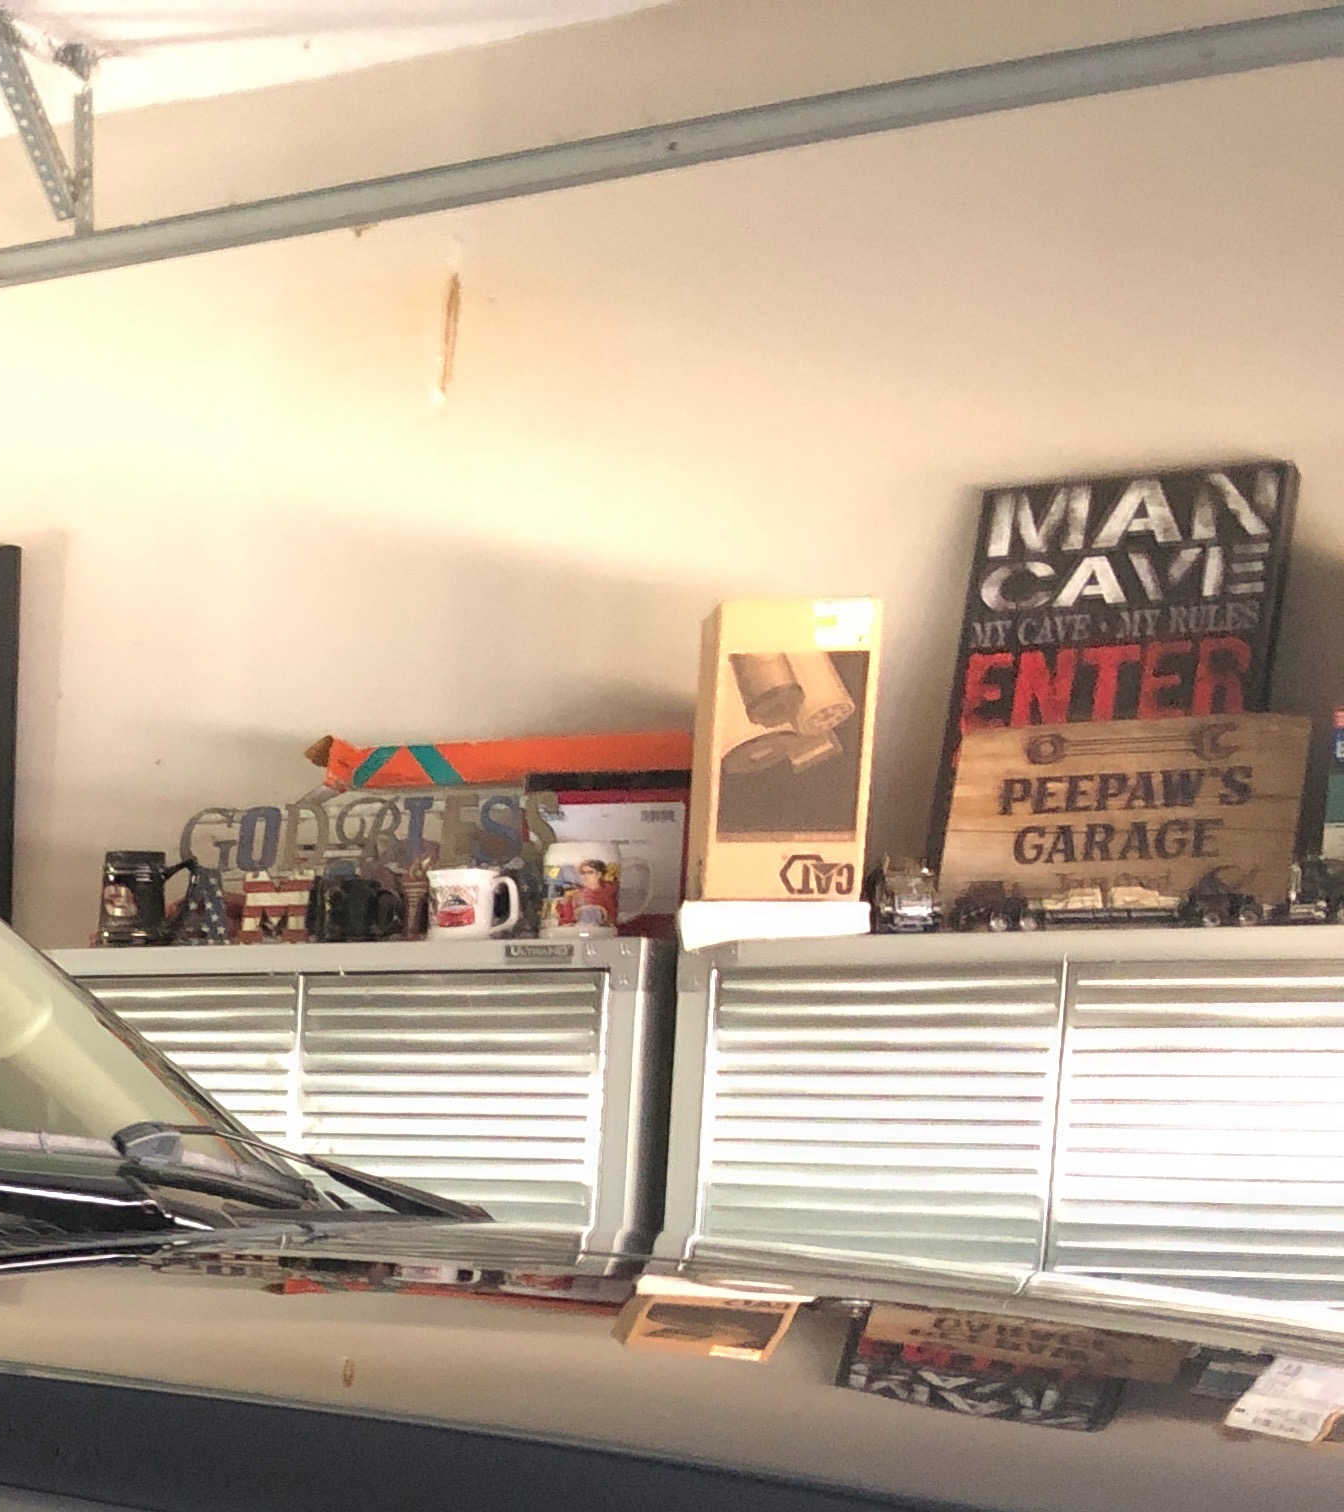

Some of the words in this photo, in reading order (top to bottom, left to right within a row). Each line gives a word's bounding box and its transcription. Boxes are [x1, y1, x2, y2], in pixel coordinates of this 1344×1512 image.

[987, 469, 1280, 558] MAN
[980, 542, 1270, 611] CAVE
[970, 619, 1012, 648] MY
[1017, 613, 1090, 645] CAVE
[1115, 609, 1162, 639] MY
[1168, 600, 1261, 635] RULES
[961, 635, 1252, 732] ENTER
[999, 765, 1253, 816] PEEPAW'S
[1013, 818, 1221, 865] GARAGE
[792, 860, 856, 895] CAT
